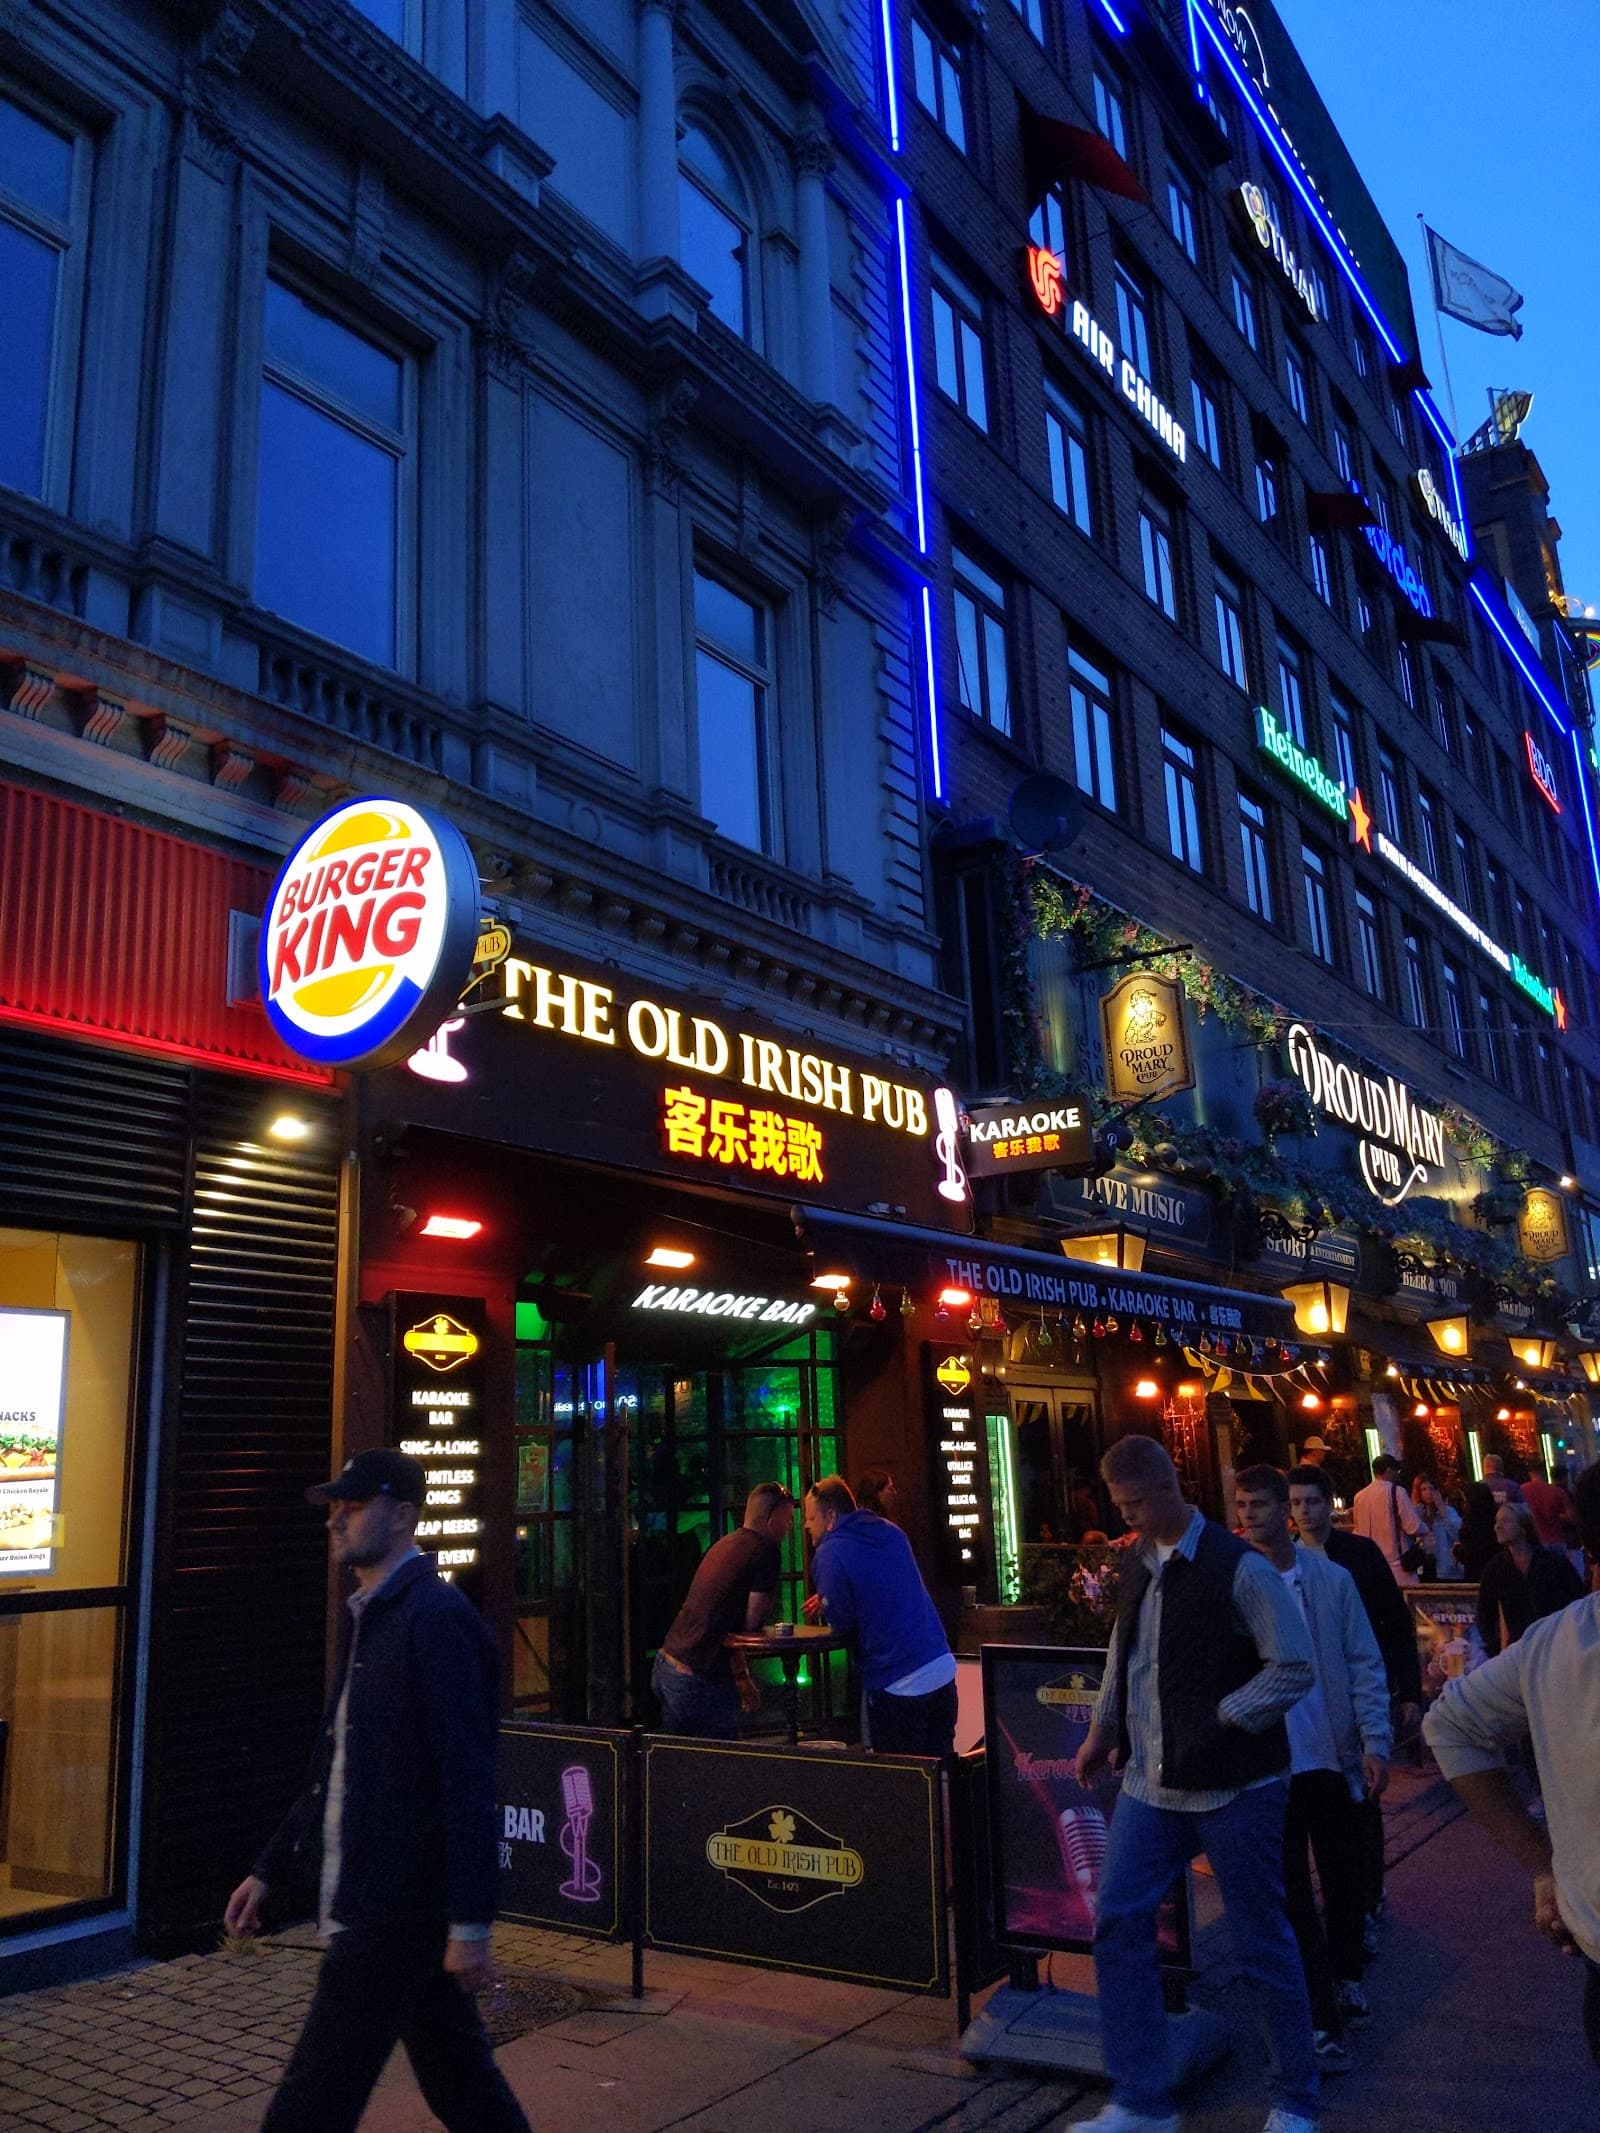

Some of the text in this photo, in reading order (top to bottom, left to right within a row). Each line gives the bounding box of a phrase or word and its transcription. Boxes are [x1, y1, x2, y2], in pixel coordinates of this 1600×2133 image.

[1074, 300, 1186, 464] AIR CHINA
[1260, 706, 1347, 820] Heineken
[277, 847, 431, 927] BURGER
[272, 891, 426, 994] KING
[502, 957, 928, 1136] THE OLD IRISH PUB
[1120, 1043, 1173, 1067] PROUD
[1131, 1057, 1170, 1074] MARY
[1141, 1070, 1158, 1079] PUB
[664, 1086, 824, 1183] 客乐我歌
[970, 1107, 1081, 1143] KARAOKE
[992, 1134, 1061, 1159] 客乐我歌
[1370, 1144, 1401, 1187] PUB
[1131, 1186, 1185, 1226] MUSIC
[632, 1284, 816, 1325] KARAOKE BAR
[946, 1259, 1197, 1322] THE OLD IRISH PUB KARAOKE BAR
[411, 1390, 470, 1406] KARAOKE
[428, 1411, 454, 1425] BAR
[400, 1440, 480, 1455] SING-A-LONG
[424, 1470, 475, 1485] UNTLESS
[425, 1490, 462, 1506] ONGS
[443, 1518, 479, 1535] BEERS
[437, 1549, 476, 1566] EVERY
[503, 1805, 545, 1844] BAR
[713, 1842, 857, 1878] THE OLD IRISH PUB
